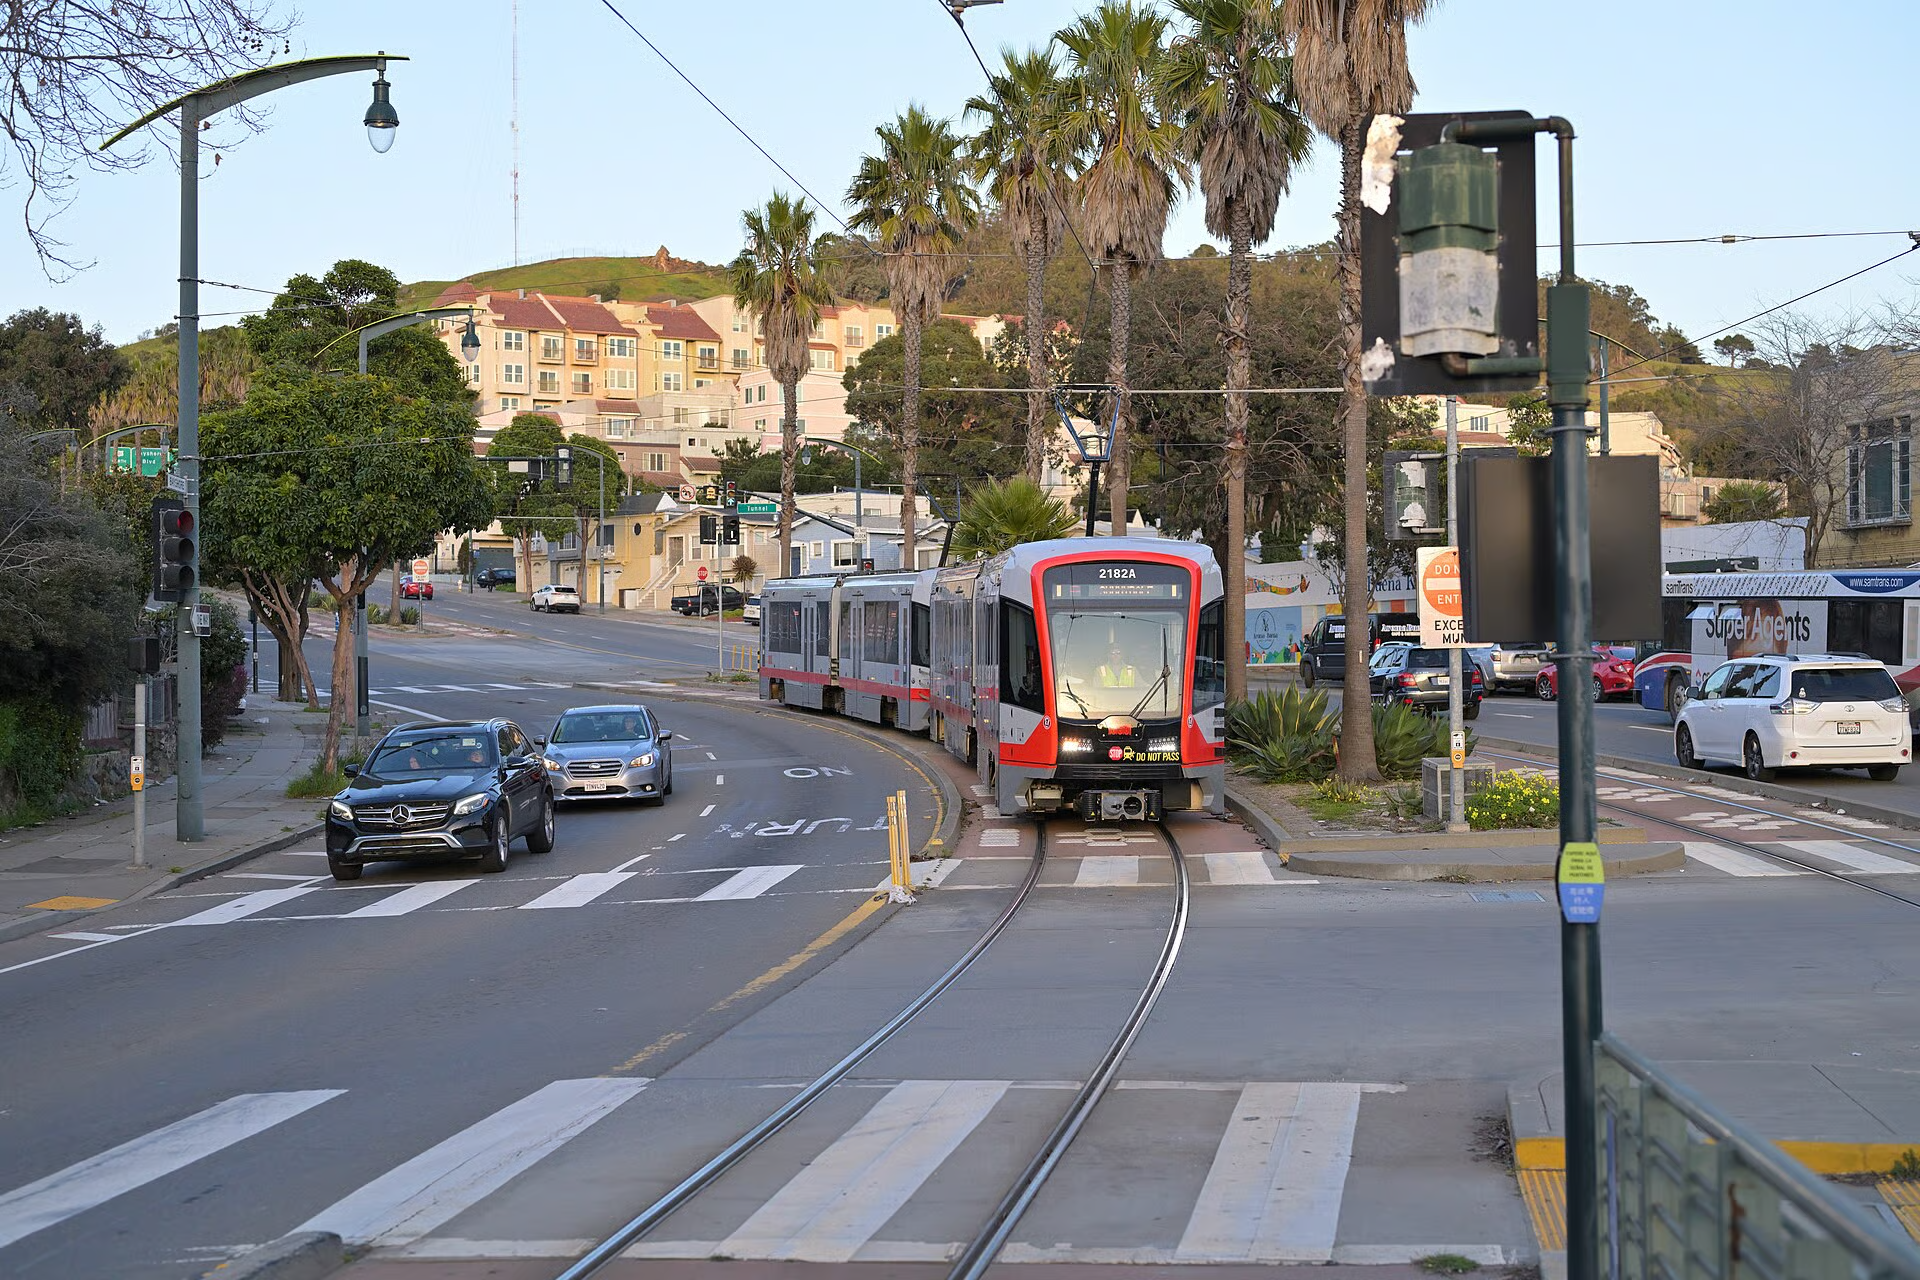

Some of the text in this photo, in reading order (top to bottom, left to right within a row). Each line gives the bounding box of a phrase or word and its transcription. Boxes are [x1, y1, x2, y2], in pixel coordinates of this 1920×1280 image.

[1098, 568, 1137, 579] 2182A
[1434, 564, 1451, 575] DO
[1665, 580, 1694, 595] samTrans
[1849, 576, 1904, 588] www.samtrans.com
[1437, 594, 1462, 605] ENT
[1434, 619, 1464, 631] EXCE
[1705, 607, 1811, 649] Super Agents
[1442, 633, 1467, 644] MUN
[1109, 750, 1123, 758] STOP
[1136, 751, 1180, 762] DO NOT PASS
